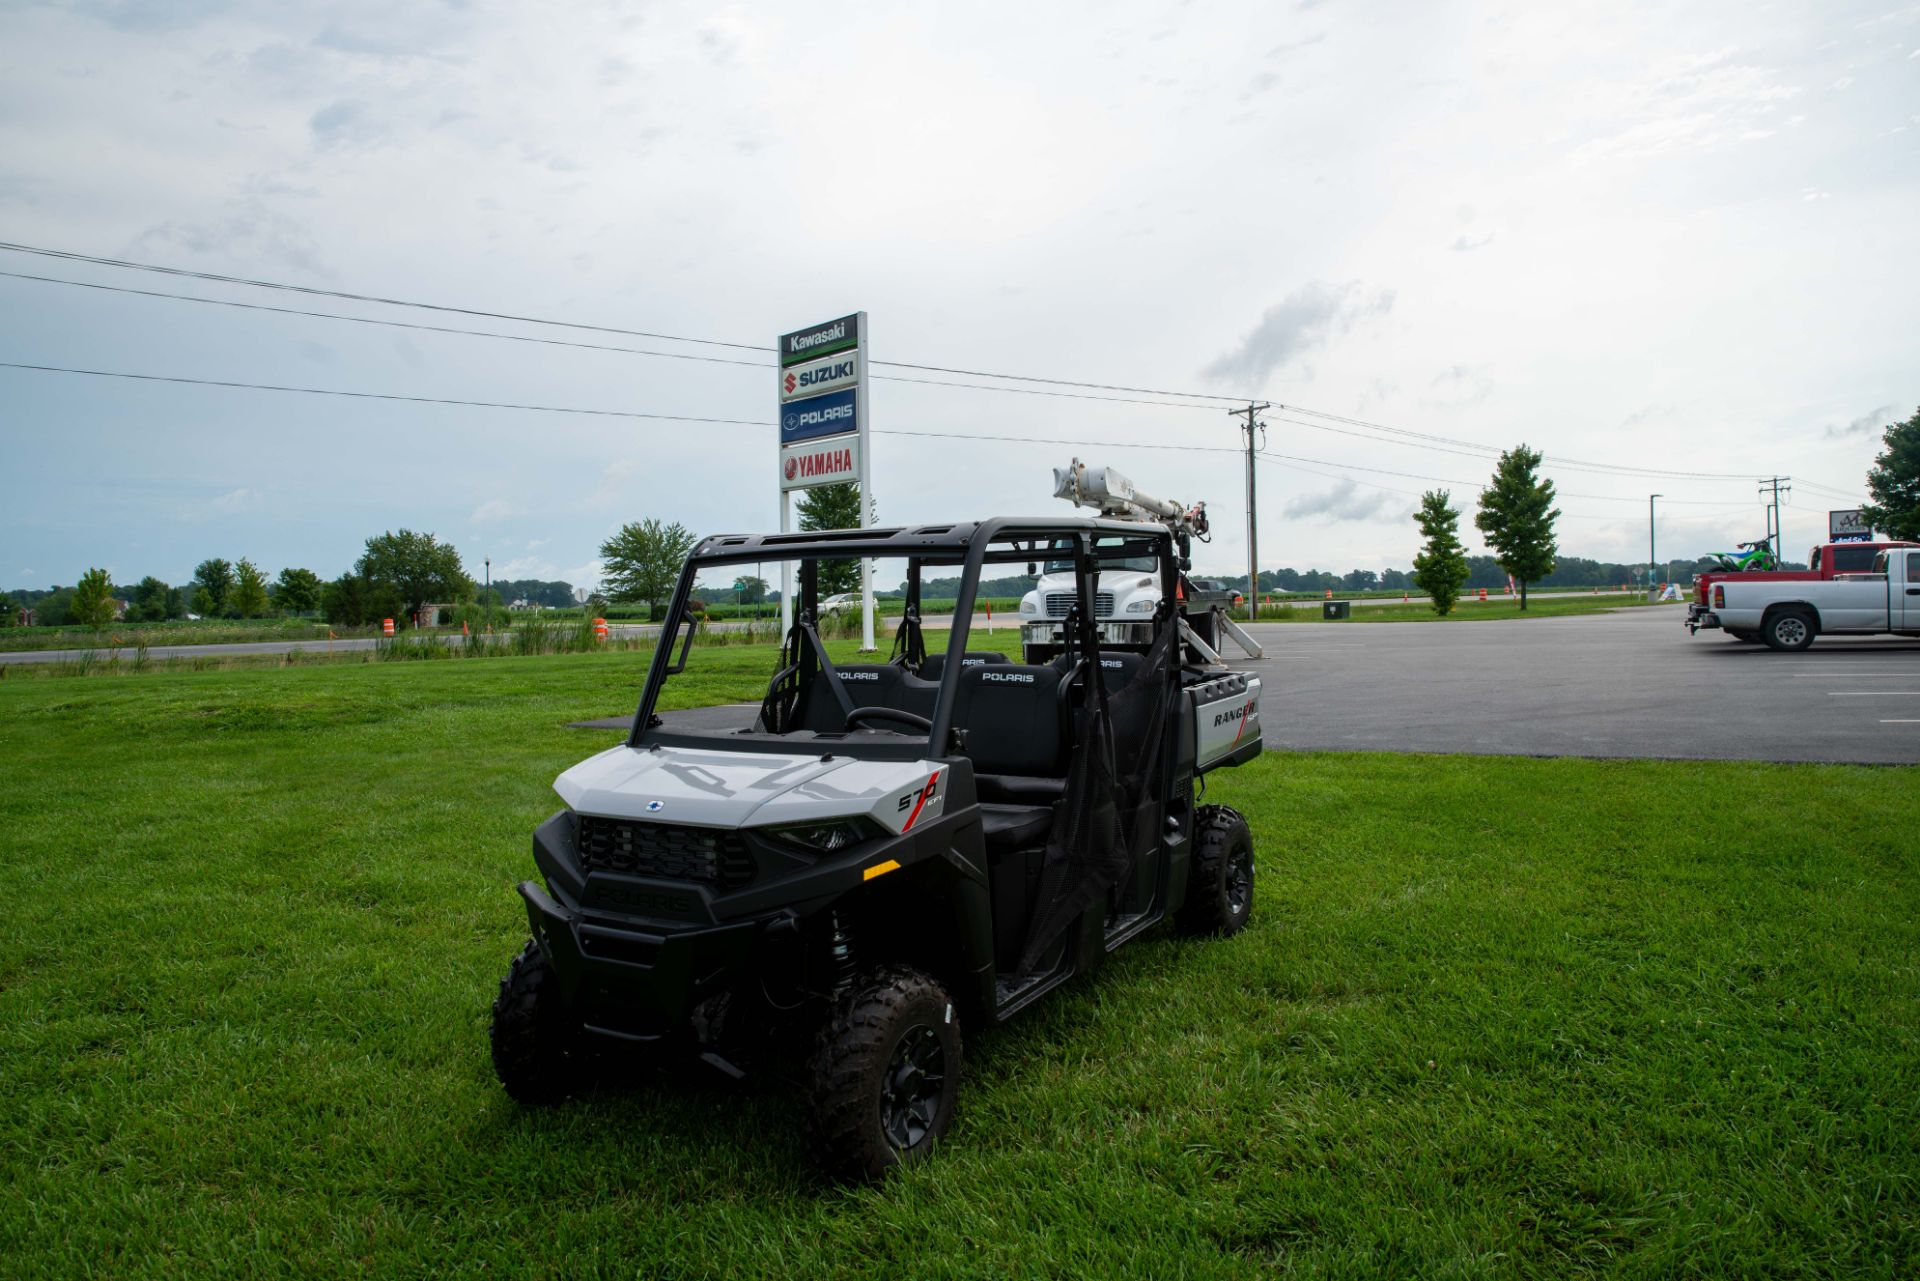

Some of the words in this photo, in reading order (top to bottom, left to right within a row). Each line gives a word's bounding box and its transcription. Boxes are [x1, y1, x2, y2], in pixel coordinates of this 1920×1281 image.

[791, 322, 844, 352] Kawasaki
[799, 361, 854, 387] SUZUKI
[800, 404, 853, 426] POLARIS
[799, 448, 852, 477] YAMAHA
[982, 672, 1034, 683] POLARIS
[1214, 702, 1255, 727] RANGER
[898, 783, 936, 812] 570
[595, 886, 689, 912] POLARIS
